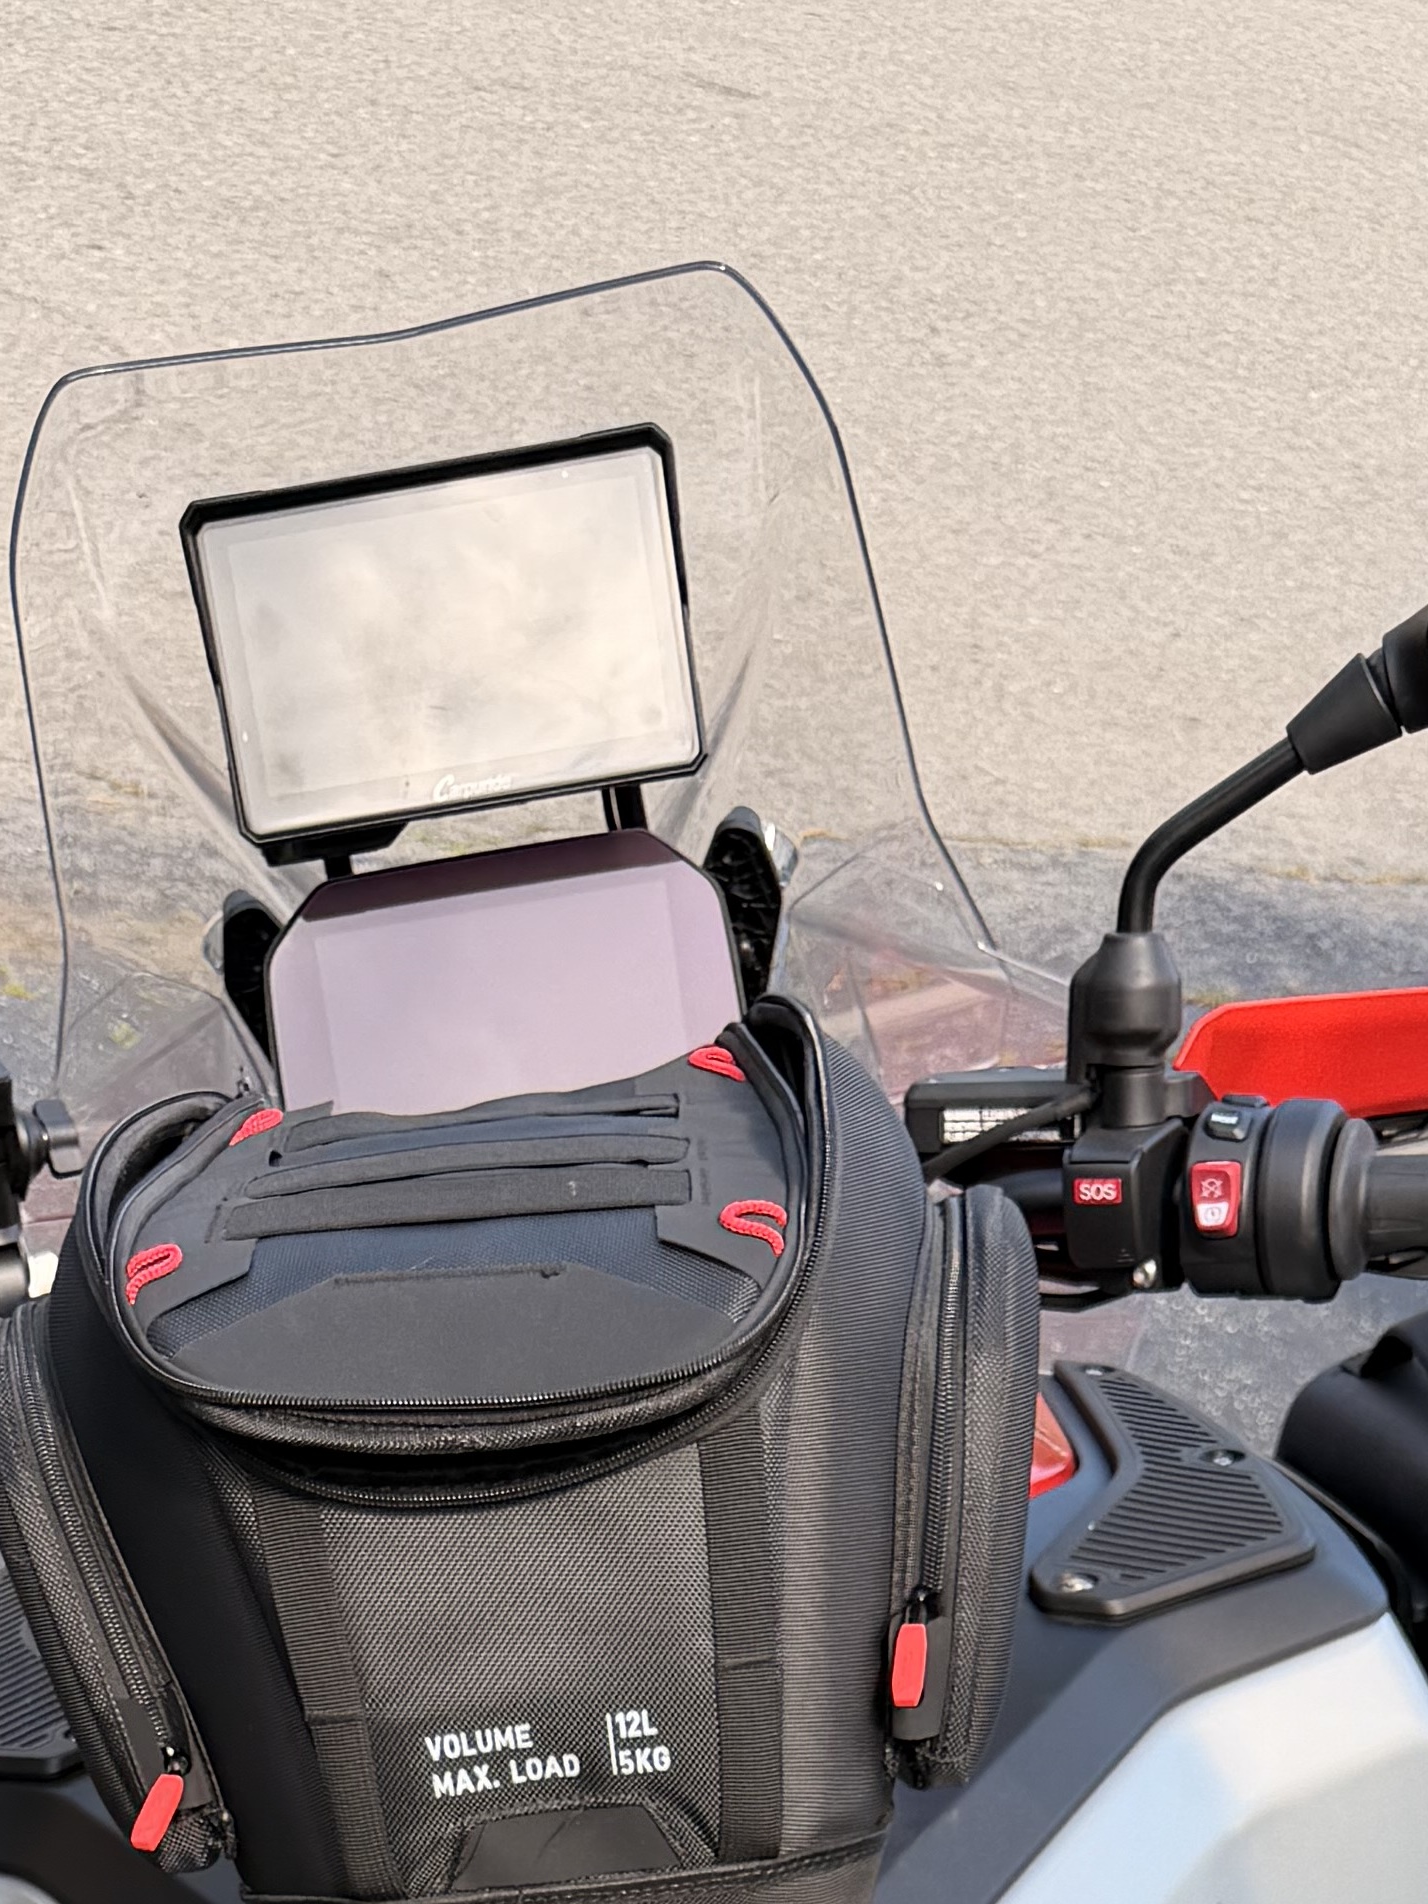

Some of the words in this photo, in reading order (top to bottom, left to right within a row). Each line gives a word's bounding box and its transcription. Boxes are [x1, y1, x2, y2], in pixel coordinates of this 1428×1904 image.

[1078, 1182, 1117, 1201] SOS
[424, 1723, 532, 1763] VOLUME
[615, 1709, 658, 1738] 12L
[431, 1766, 501, 1799] MAX.
[511, 1753, 581, 1784] LOAD
[619, 1746, 672, 1776] 5KG
